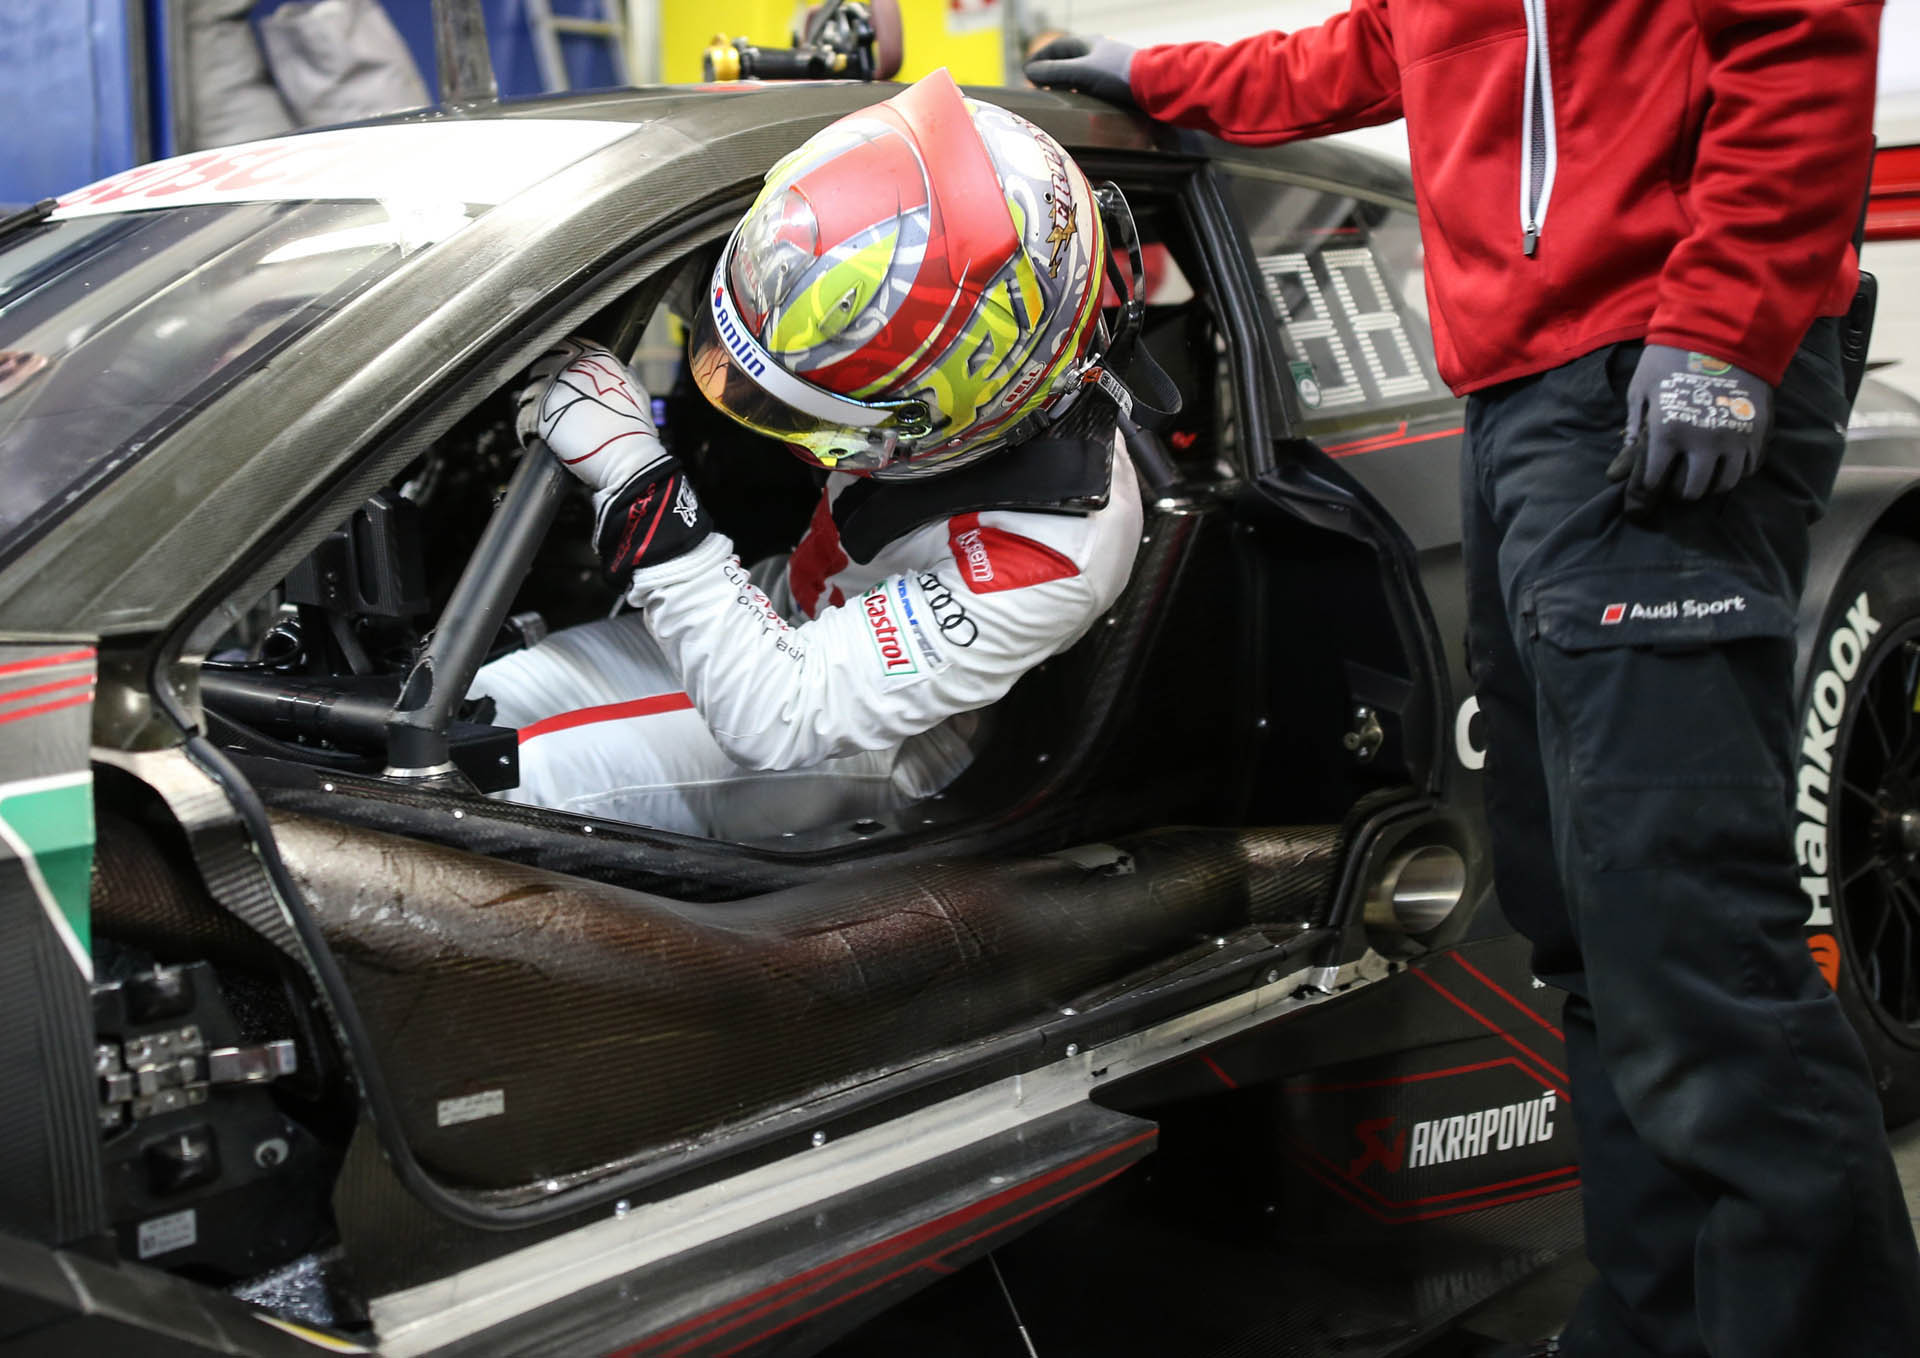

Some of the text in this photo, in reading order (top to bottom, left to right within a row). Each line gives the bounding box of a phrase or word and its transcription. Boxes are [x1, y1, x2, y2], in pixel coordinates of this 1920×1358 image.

[1004, 368, 1041, 403] BELL
[1629, 595, 1747, 620] Audi Sport
[863, 593, 912, 671] Castrol
